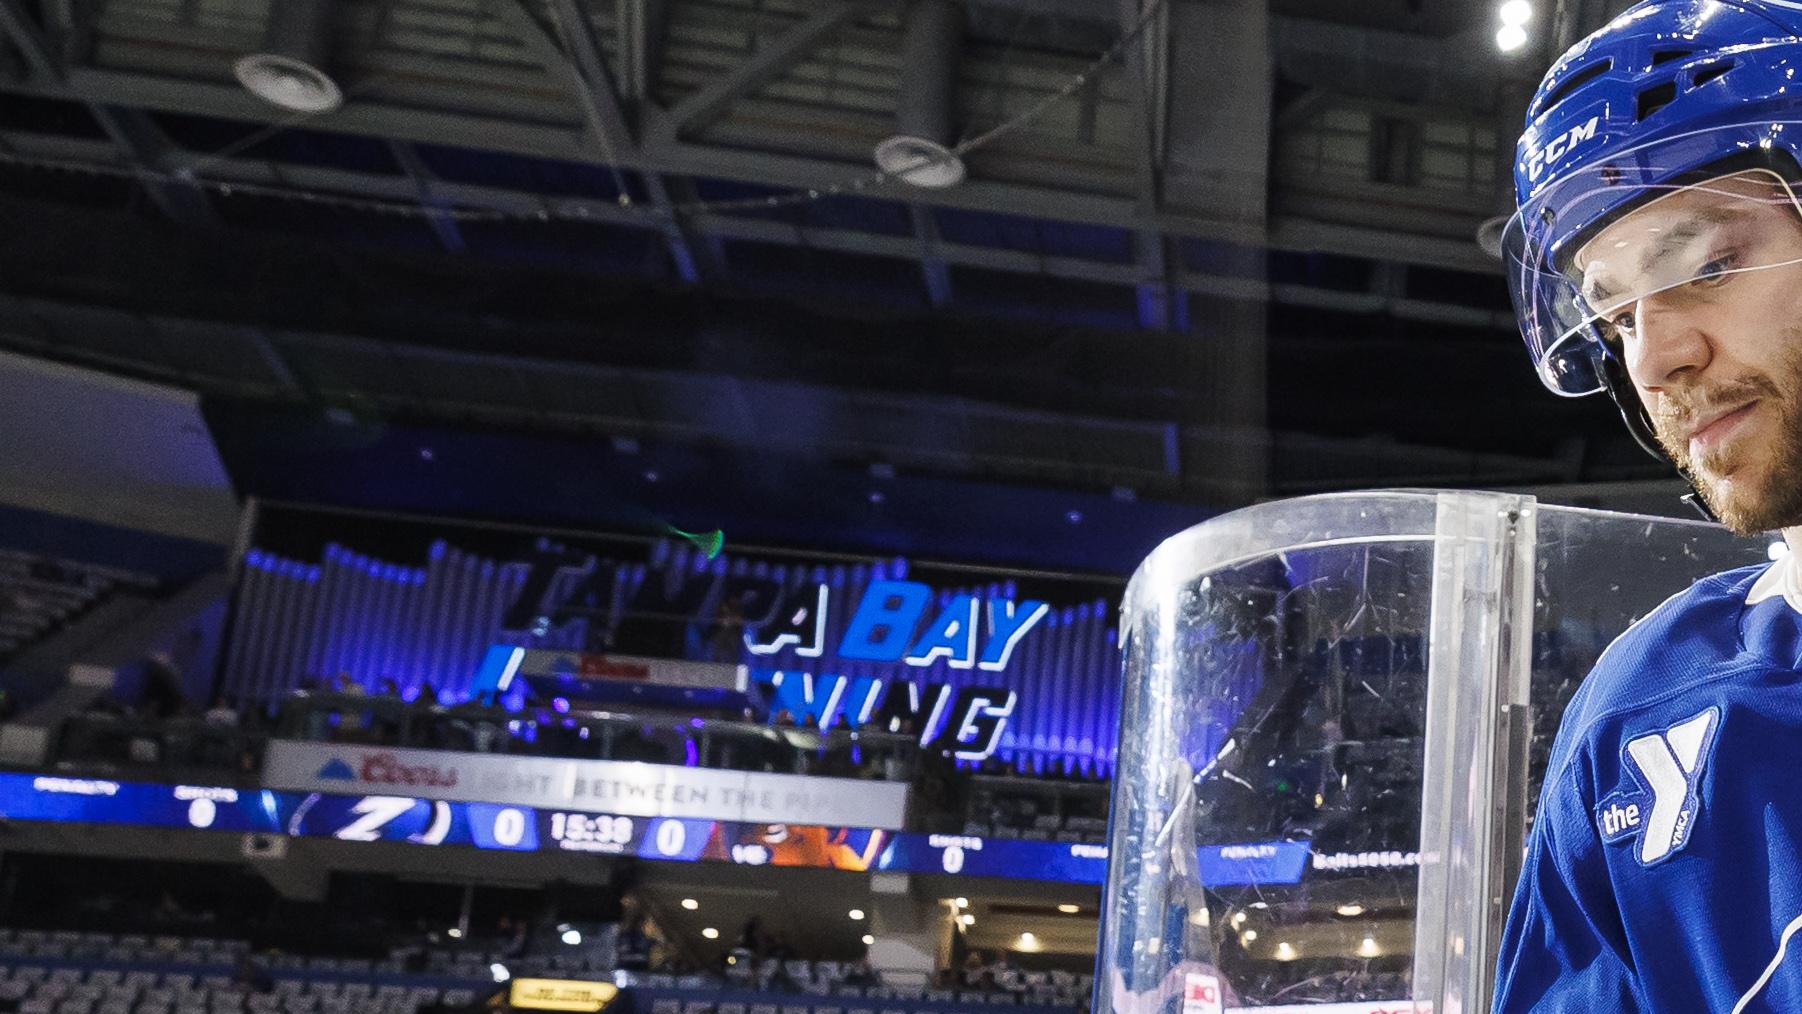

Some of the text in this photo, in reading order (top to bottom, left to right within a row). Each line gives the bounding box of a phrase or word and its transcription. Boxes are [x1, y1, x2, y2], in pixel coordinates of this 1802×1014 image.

[1528, 117, 1599, 181] CCM
[838, 577, 1050, 671] BAY
[493, 808, 525, 846] 0
[656, 819, 686, 856] 0
[1603, 803, 1641, 835] the
[1671, 809, 1691, 846] YMCA
